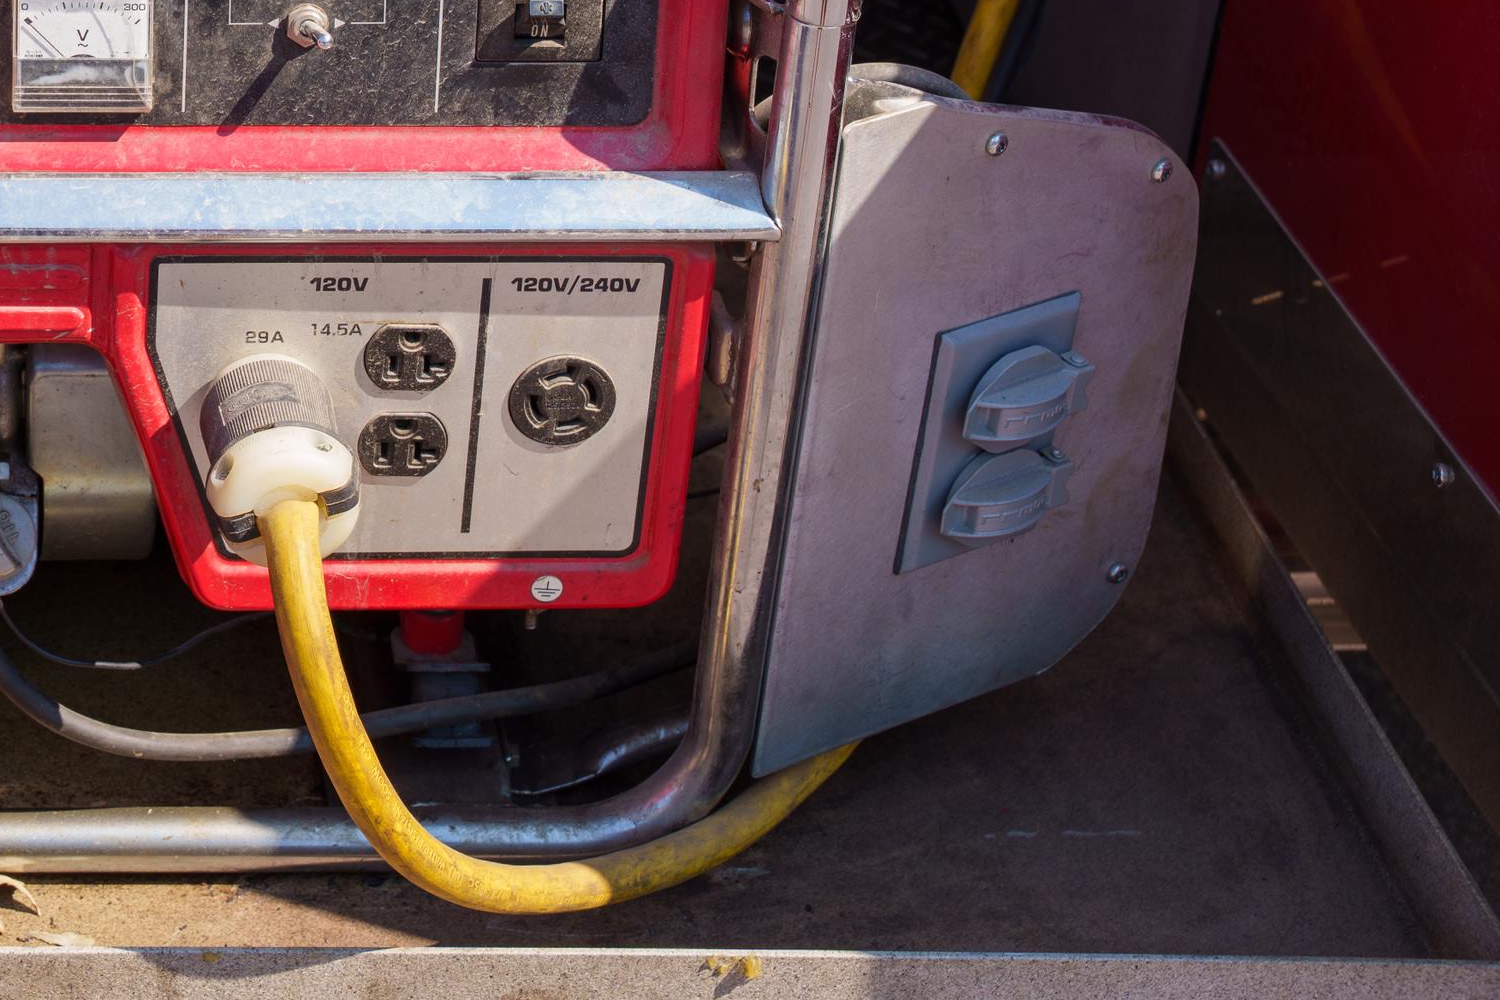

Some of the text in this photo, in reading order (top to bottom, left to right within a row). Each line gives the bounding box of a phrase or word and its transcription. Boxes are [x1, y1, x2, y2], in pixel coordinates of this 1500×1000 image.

[20, 2, 29, 11] 0
[123, 3, 147, 11] 300
[77, 29, 90, 42] V
[531, 24, 549, 38] ON
[310, 277, 369, 292] 120V
[511, 275, 641, 293] 120V/240V
[311, 323, 362, 337] 14.5A
[245, 331, 284, 344] 29A
